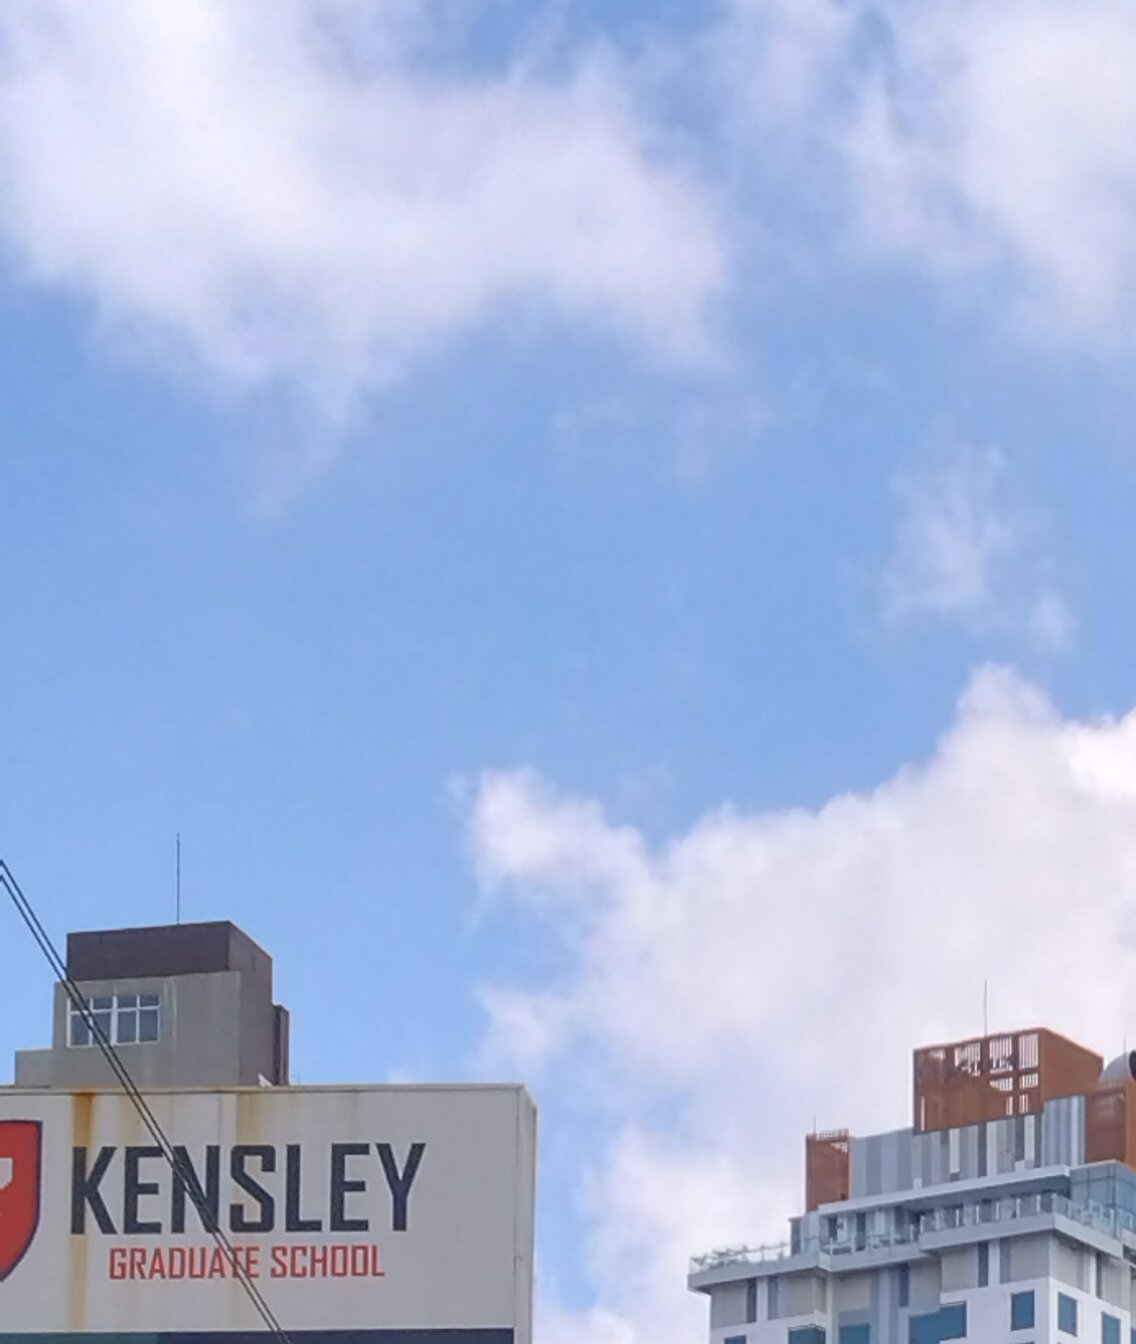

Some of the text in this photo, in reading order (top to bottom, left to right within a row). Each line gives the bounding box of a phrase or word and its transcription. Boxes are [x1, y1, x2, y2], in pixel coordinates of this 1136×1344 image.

[70, 1143, 427, 1235] KENSLEY
[109, 1245, 385, 1280] GRADUATE SCHOOL
